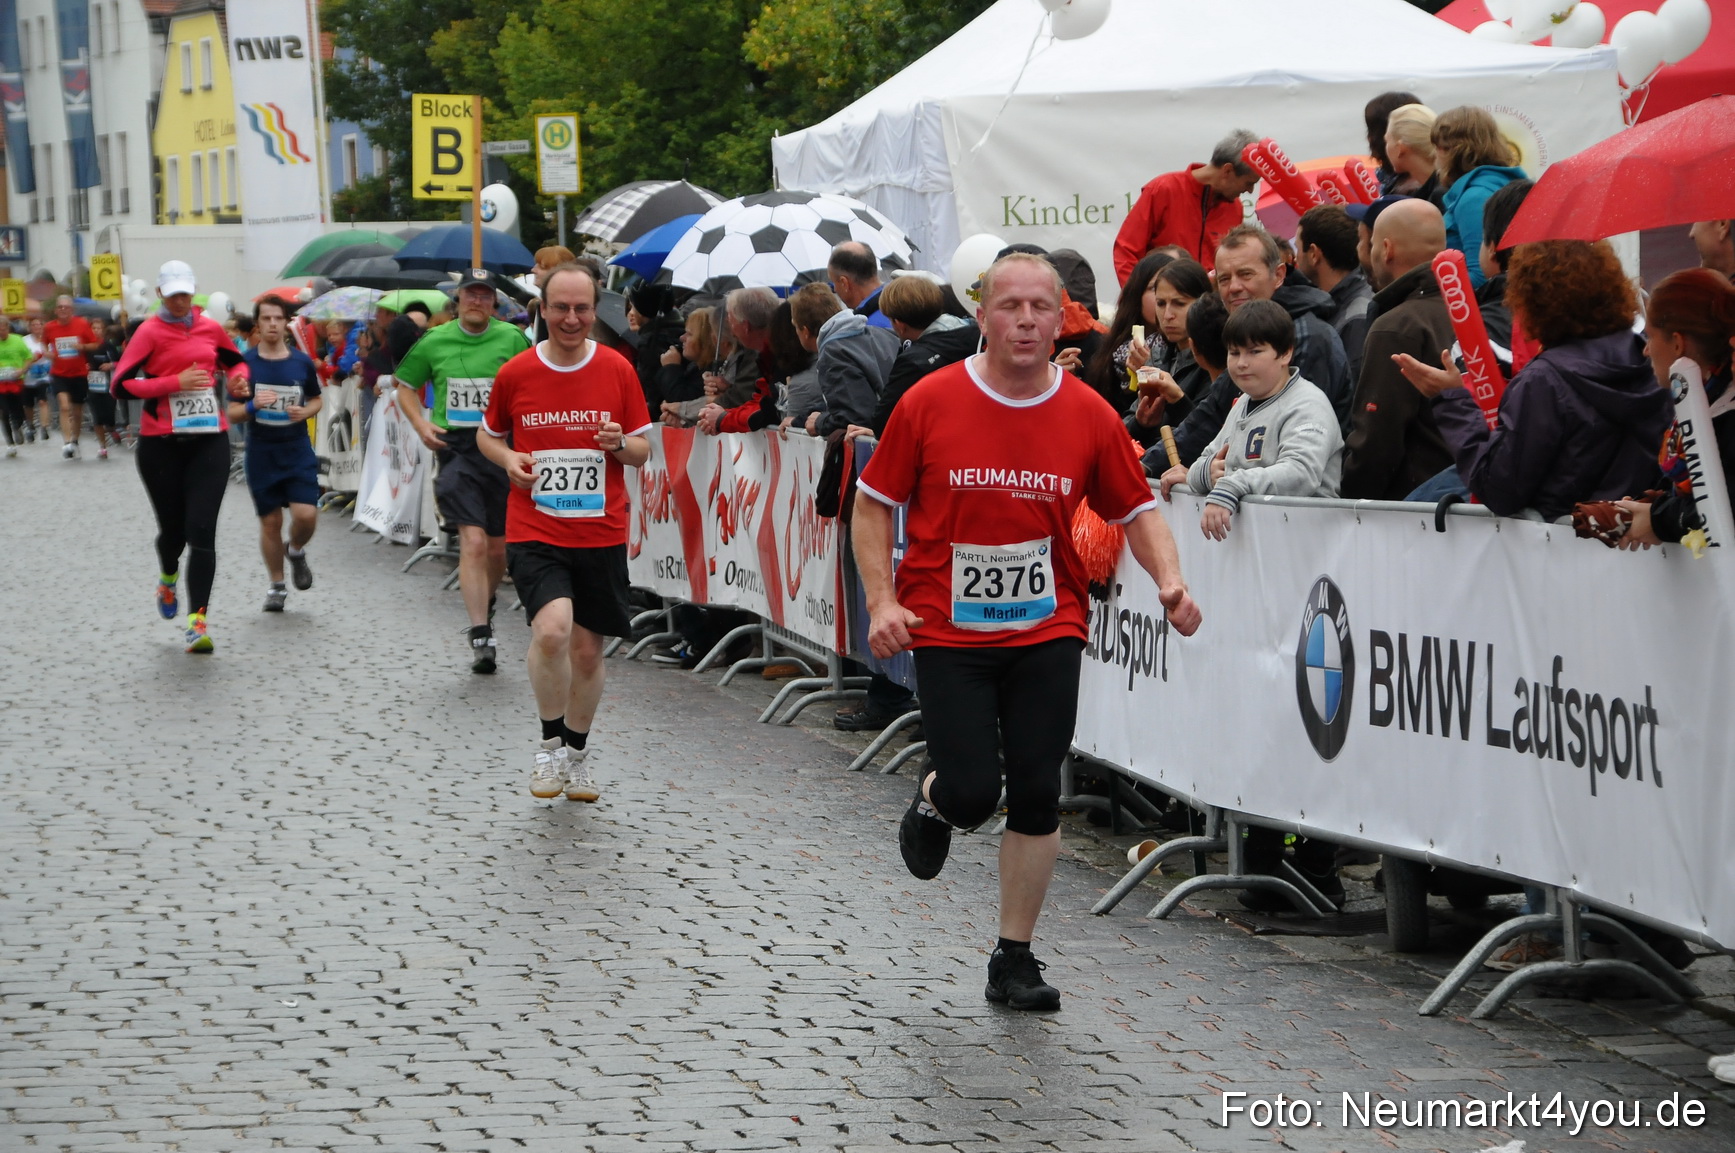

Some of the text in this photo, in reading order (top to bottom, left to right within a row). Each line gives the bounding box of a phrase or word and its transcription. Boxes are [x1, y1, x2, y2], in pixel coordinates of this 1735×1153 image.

[421, 99, 473, 118] Block
[194, 118, 216, 143] HOTEL
[550, 126, 564, 143] H
[1495, 104, 1548, 167] EINSAMEN KINDERN
[431, 126, 464, 176] B
[1001, 193, 1115, 227] Kinder
[91, 256, 117, 265] Block
[98, 267, 114, 290] C
[7, 288, 20, 306] D
[1464, 345, 1495, 400] BKK
[176, 398, 214, 416] 2223
[450, 390, 491, 407] 3143
[521, 410, 598, 427] NEUMARKT
[1245, 425, 1267, 462] G
[540, 466, 598, 492] 2373
[950, 468, 1058, 491] NEUMARKT
[556, 497, 583, 508] Frank
[1011, 491, 1056, 503] STARKE STADT
[955, 550, 1036, 563] PARTL Neumarkt
[963, 561, 1046, 599] 2376
[983, 606, 1027, 620] Martin
[1303, 582, 1349, 641] BMW
[1370, 629, 1663, 797] BMW Laufsport
